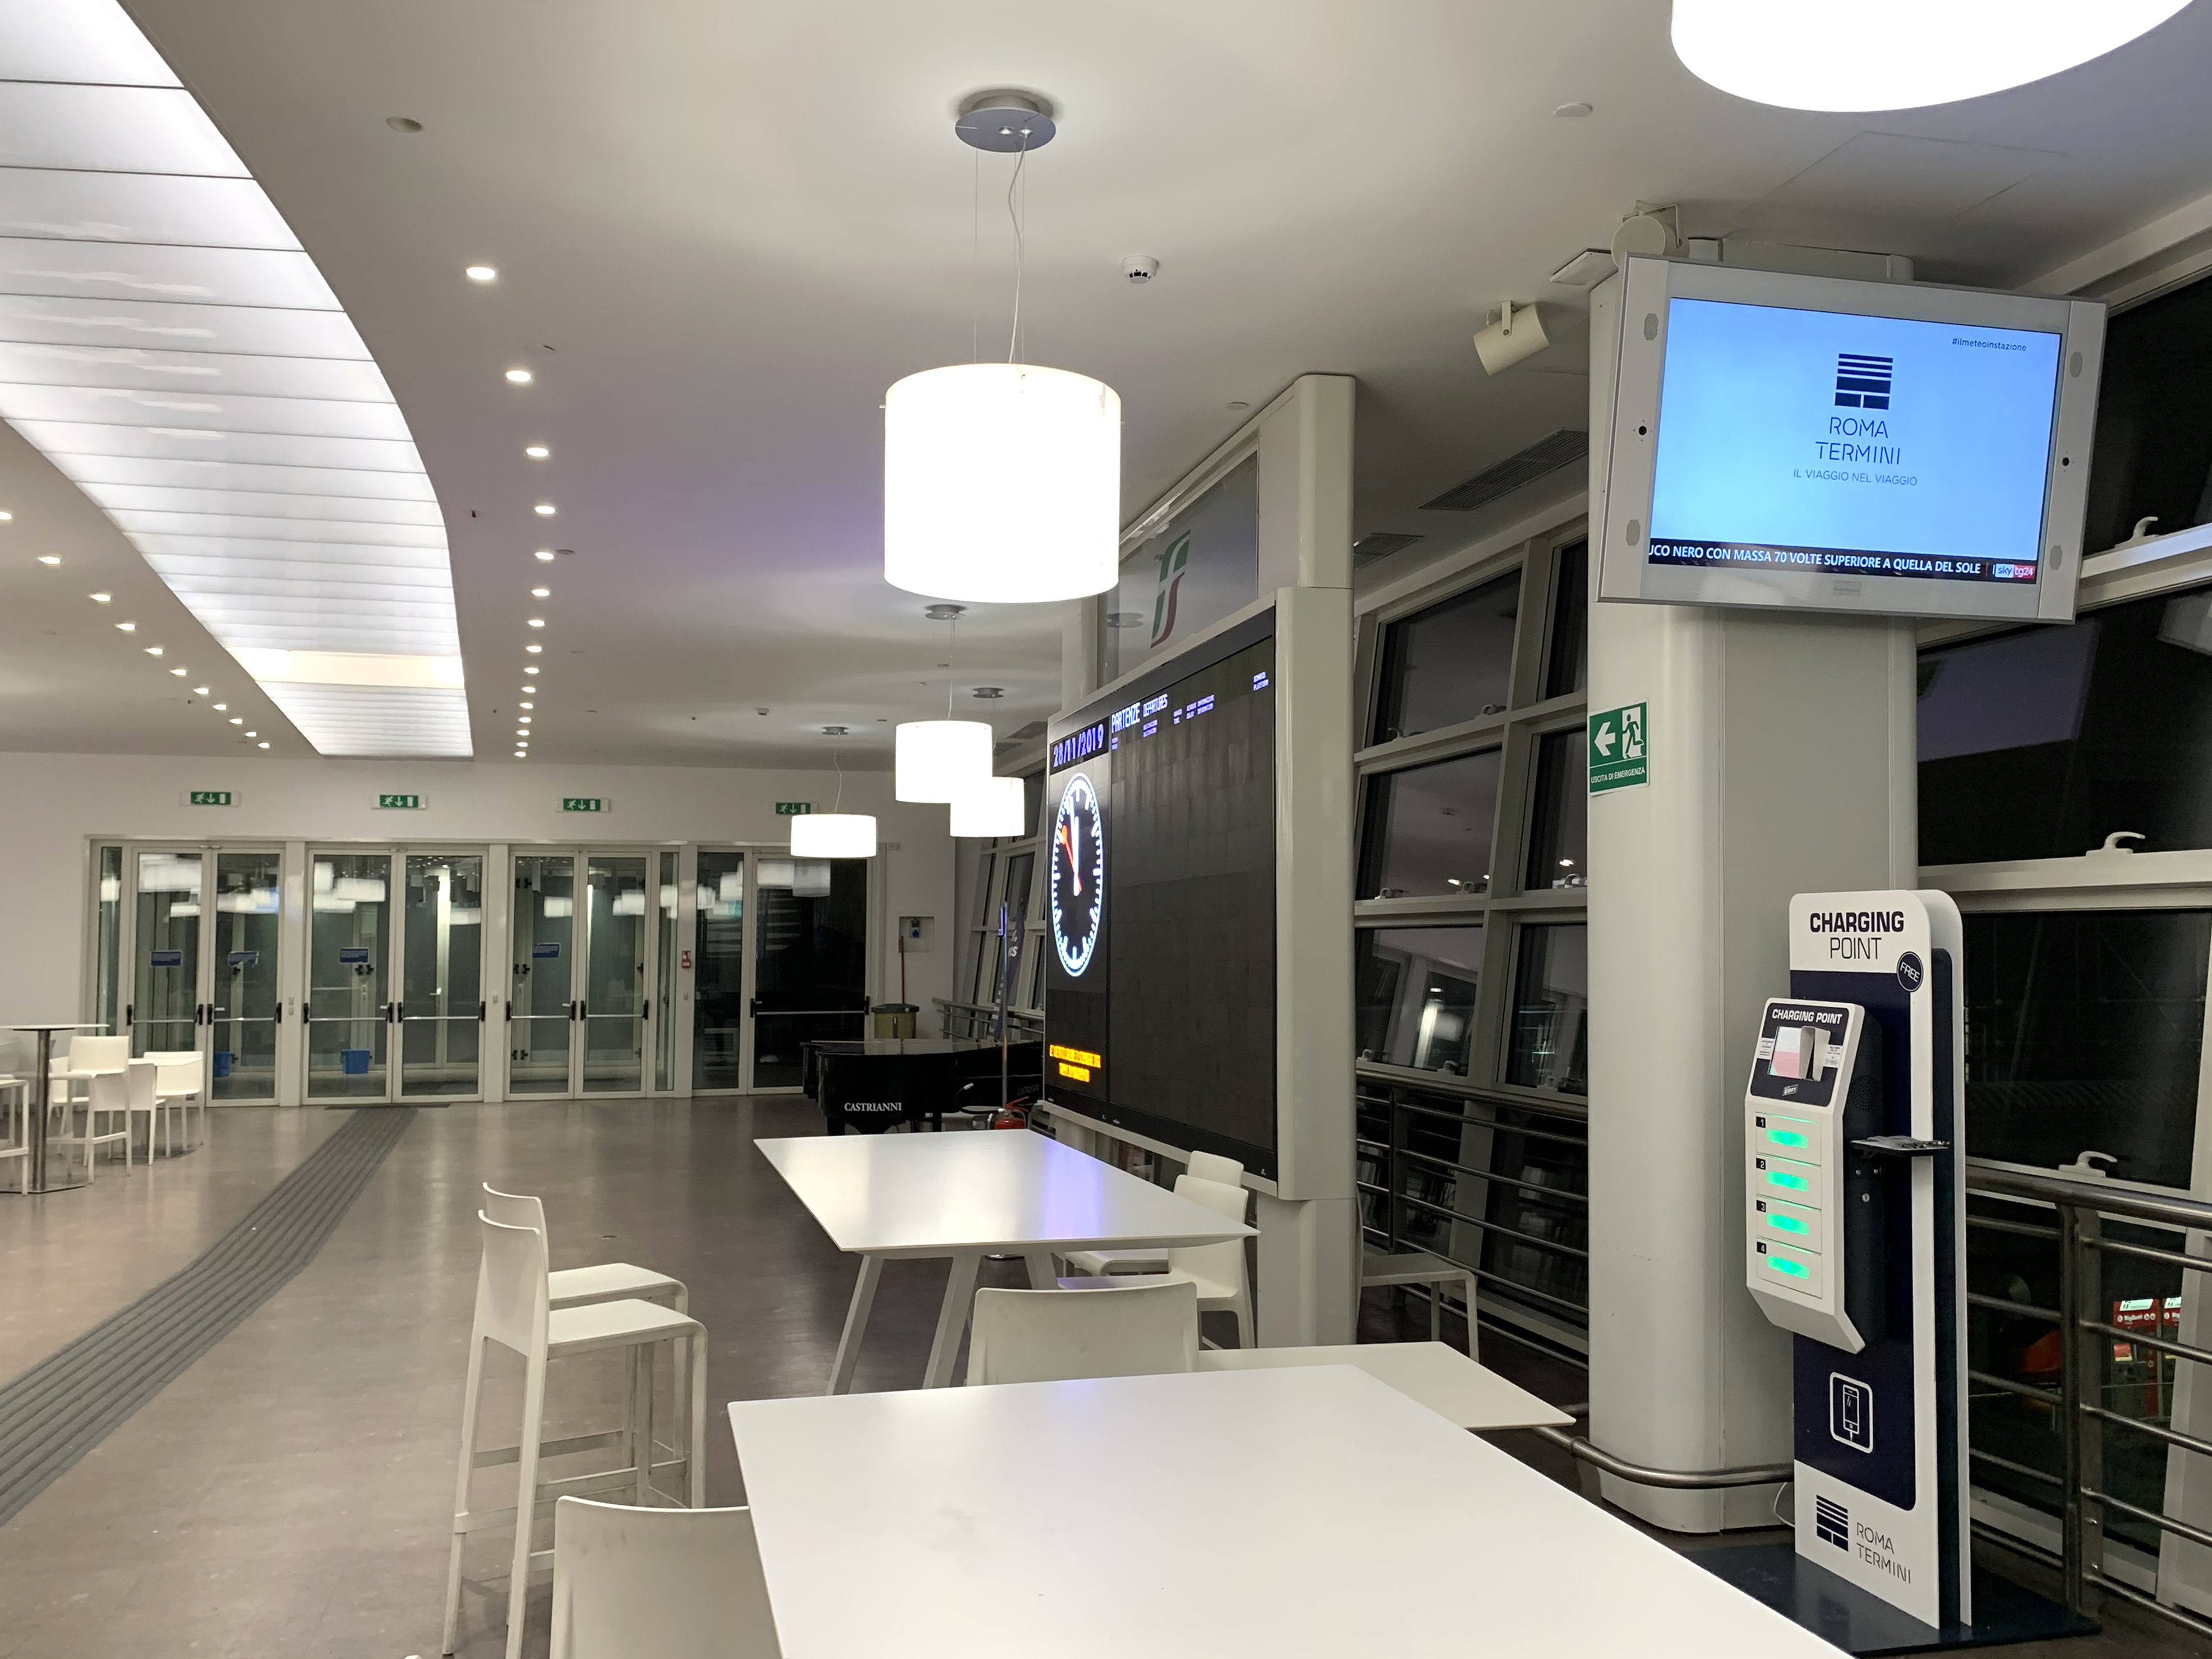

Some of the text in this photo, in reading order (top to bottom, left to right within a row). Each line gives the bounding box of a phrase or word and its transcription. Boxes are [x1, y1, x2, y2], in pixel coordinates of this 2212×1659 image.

[1952, 338, 2027, 351] #ilmeteoinstazione
[1829, 417, 1888, 438] ROMA
[1815, 441, 1900, 464] TERMINI
[1794, 468, 1918, 486] IL VIAGGIO NEL VIAGGIO
[1672, 546, 1704, 559] NERO
[1706, 547, 1731, 560] CON
[1734, 549, 1772, 562] MASSA
[1775, 551, 1787, 563] 70
[1789, 552, 1822, 565] VOLTE
[1824, 554, 1881, 568] SUPERIORE
[1882, 560, 1891, 569] A
[1893, 558, 1933, 572] QUELLA
[1935, 561, 1954, 573] DEL
[1955, 563, 1981, 574] SOLE
[1998, 564, 2033, 577] sky tg24
[1112, 702, 1140, 734] PARTENZE
[1143, 693, 1168, 717] DEPARTURES
[1053, 723, 1104, 768] 28/11/2019
[1591, 774, 1608, 784] USCITA
[1614, 767, 1646, 779] EMERGENZA
[1810, 911, 1904, 933] CHARGING
[1830, 937, 1882, 960] POINT
[1900, 961, 1920, 983] FREE
[1772, 1009, 1843, 1025] CHARGING POINT
[844, 1102, 902, 1112] CASTRIANNI
[1856, 1522, 1895, 1555] ROMA
[1856, 1543, 1910, 1584] TERMINI
